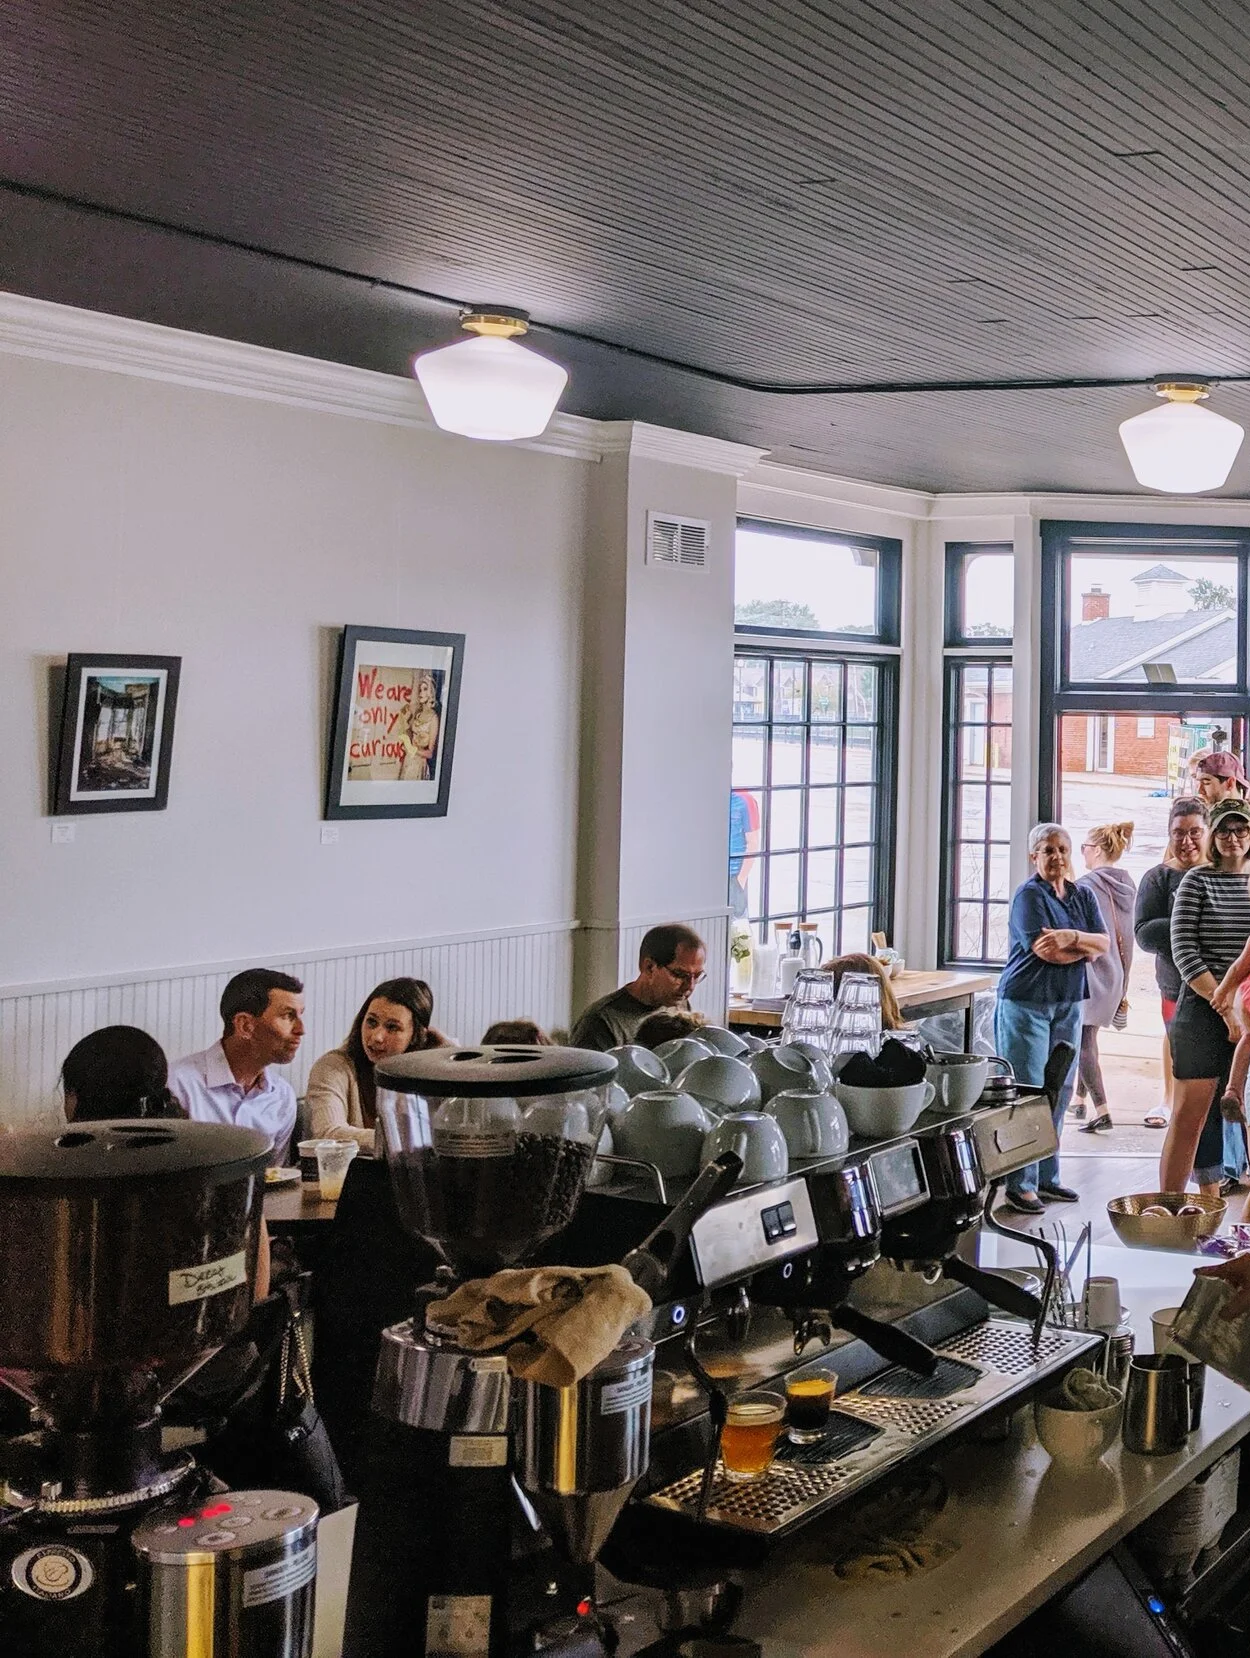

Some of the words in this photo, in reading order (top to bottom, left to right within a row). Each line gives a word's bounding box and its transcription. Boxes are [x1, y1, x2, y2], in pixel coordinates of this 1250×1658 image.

[358, 667, 384, 700] We
[387, 685, 413, 703] are
[359, 708, 399, 733] only
[349, 736, 407, 762] curious
